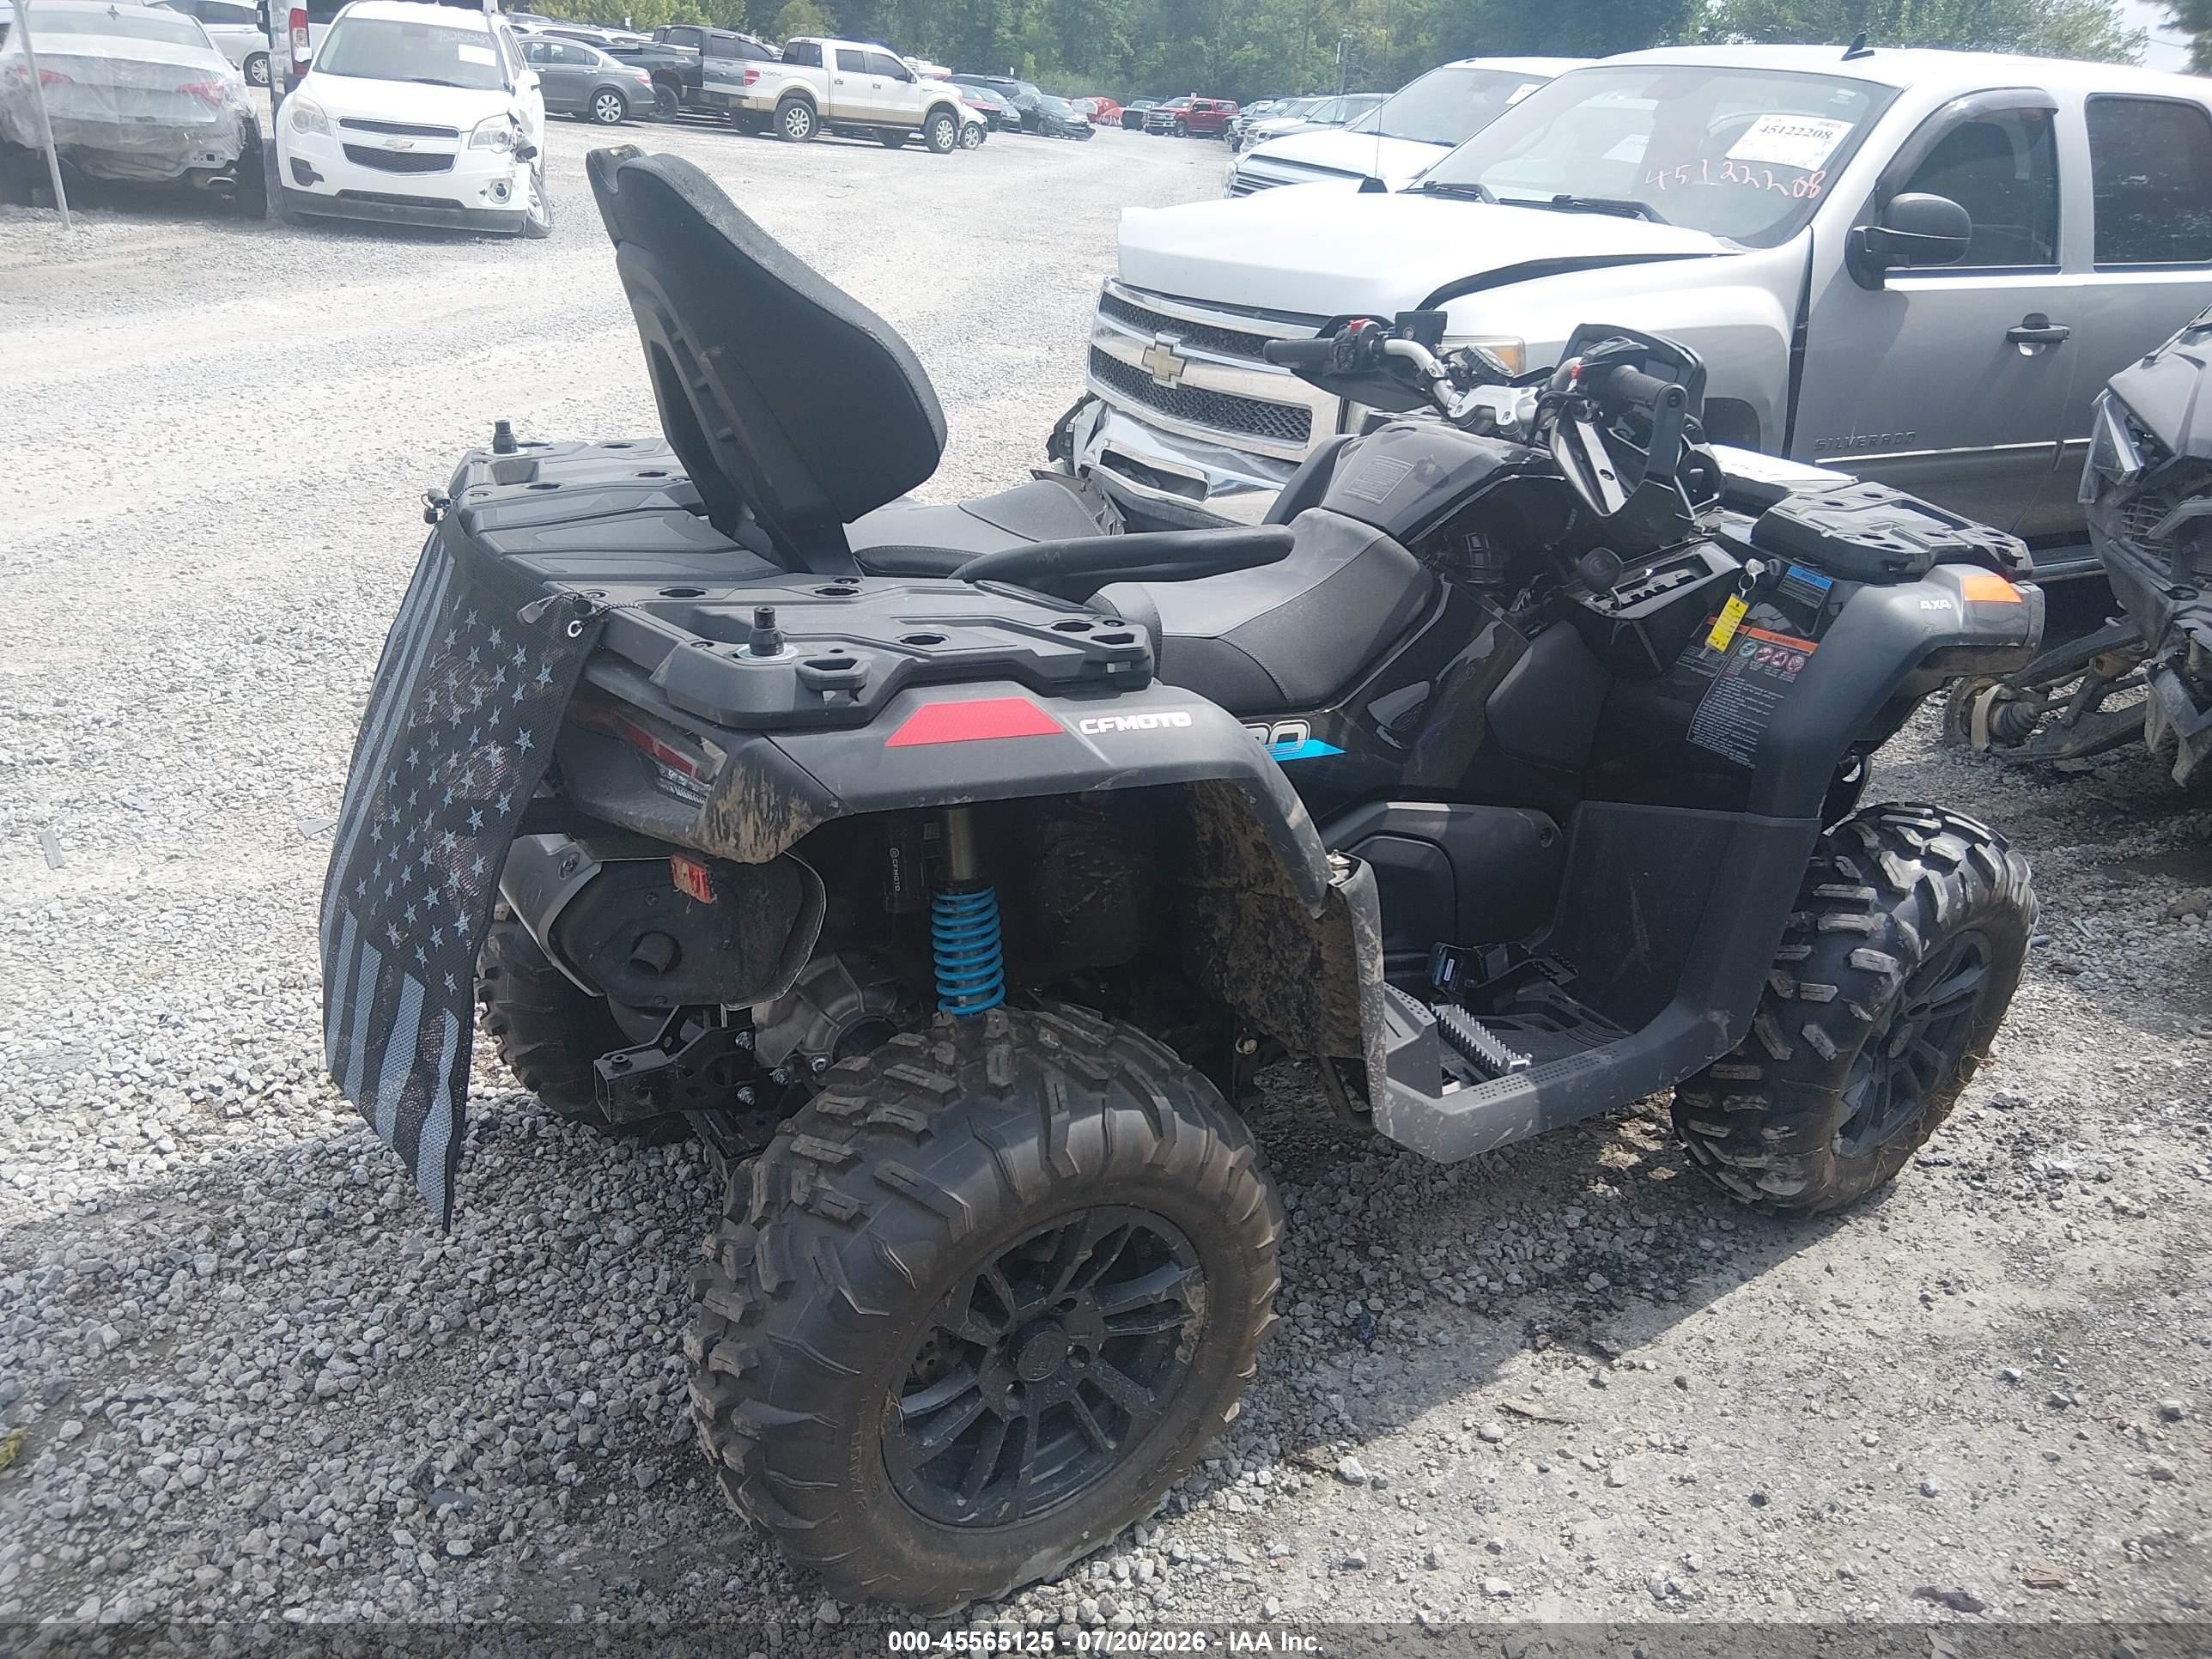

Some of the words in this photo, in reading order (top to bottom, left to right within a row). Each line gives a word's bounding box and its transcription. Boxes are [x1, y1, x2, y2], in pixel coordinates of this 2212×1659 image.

[1759, 124, 1833, 140] 45122208
[1645, 159, 1826, 199] 45122208
[1920, 599, 1952, 610] 4X4
[1079, 711, 1193, 735] CFMOTO
[892, 859, 901, 892] CFMOTO
